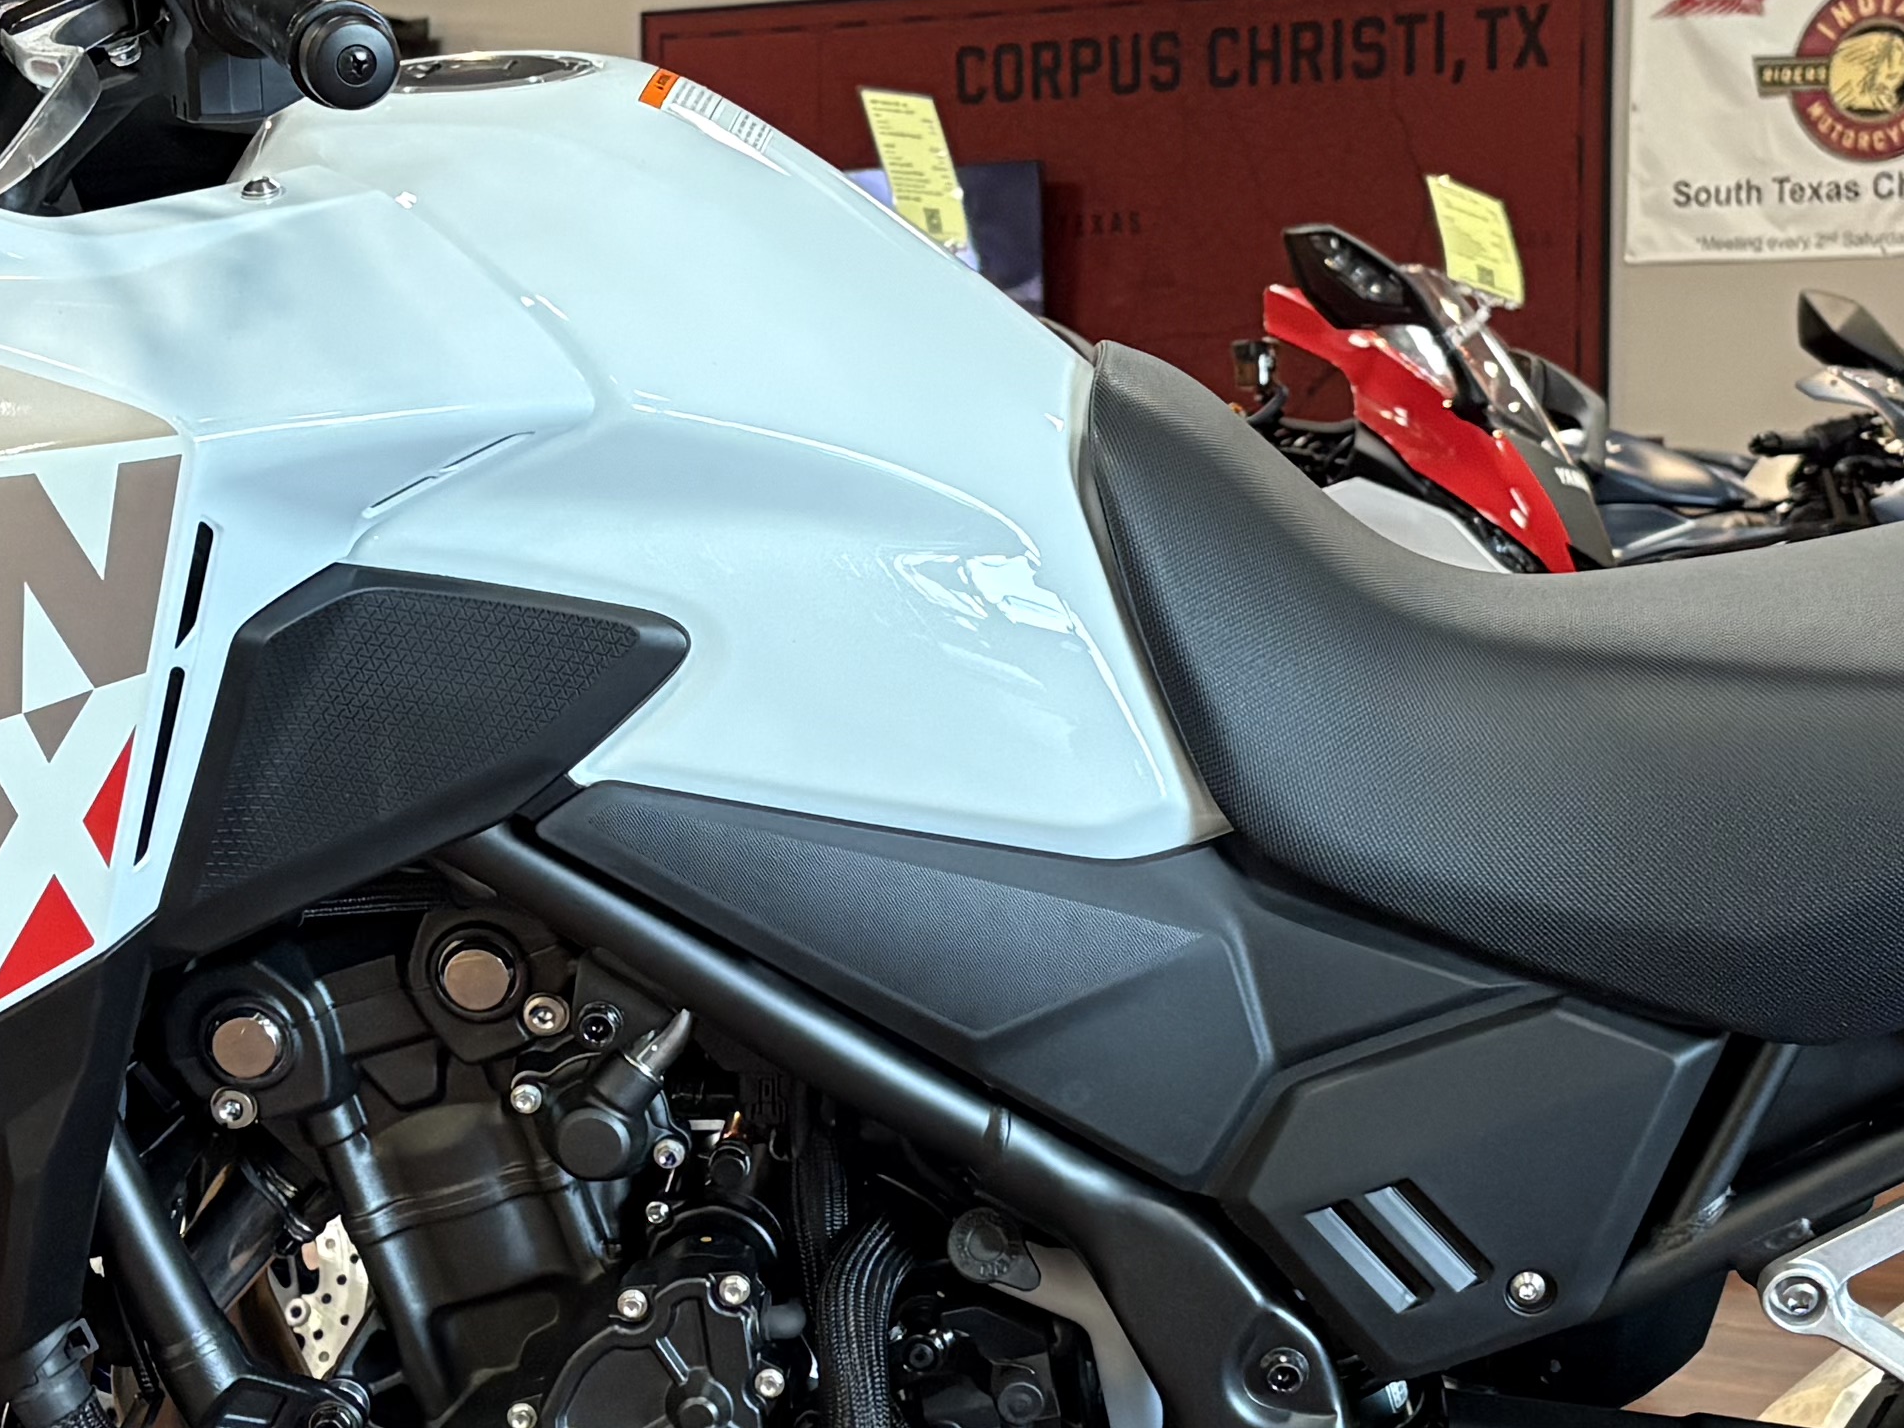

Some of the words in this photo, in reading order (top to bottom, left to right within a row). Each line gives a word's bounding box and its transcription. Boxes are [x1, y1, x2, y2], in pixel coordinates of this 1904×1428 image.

[956, 29, 1181, 105] CORPUS
[1761, 66, 1828, 83] RIDERS
[1673, 177, 1762, 207] South
[1771, 175, 1860, 204] Texas
